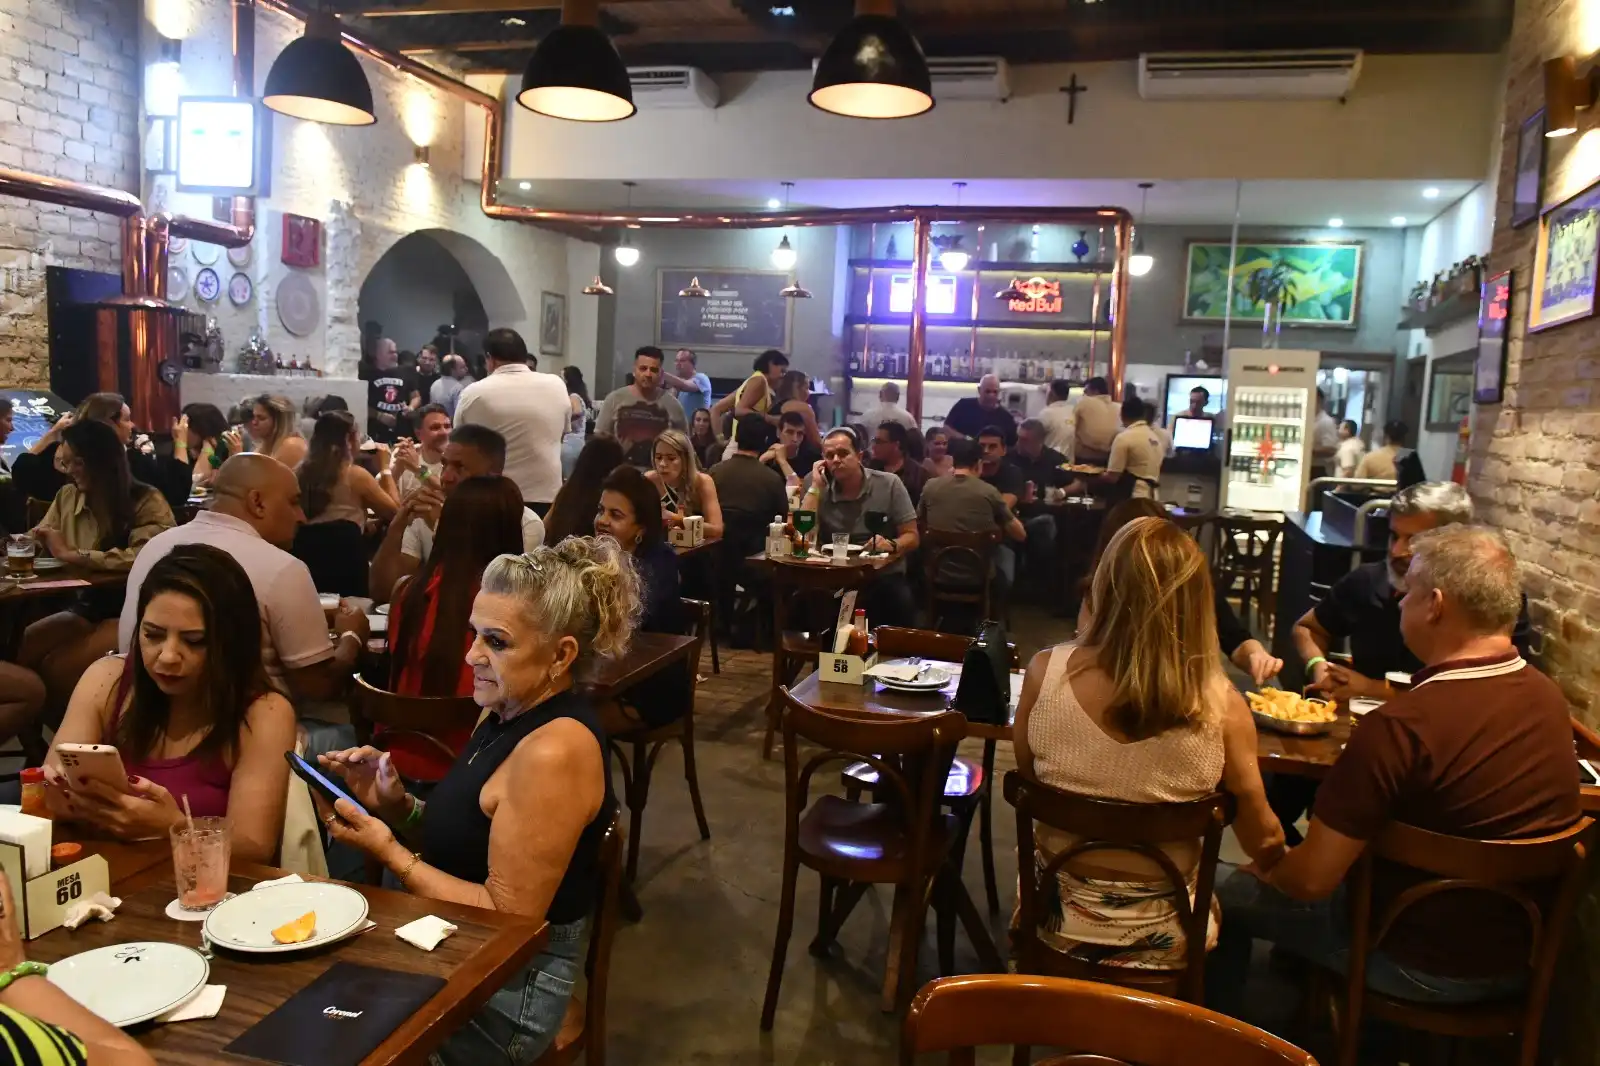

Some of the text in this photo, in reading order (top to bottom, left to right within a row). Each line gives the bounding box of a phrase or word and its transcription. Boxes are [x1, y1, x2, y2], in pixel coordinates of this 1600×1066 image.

[1008, 297, 1062, 313] Red Bull
[833, 663, 848, 673] 58
[57, 872, 80, 888] MESA
[56, 880, 82, 905] 60
